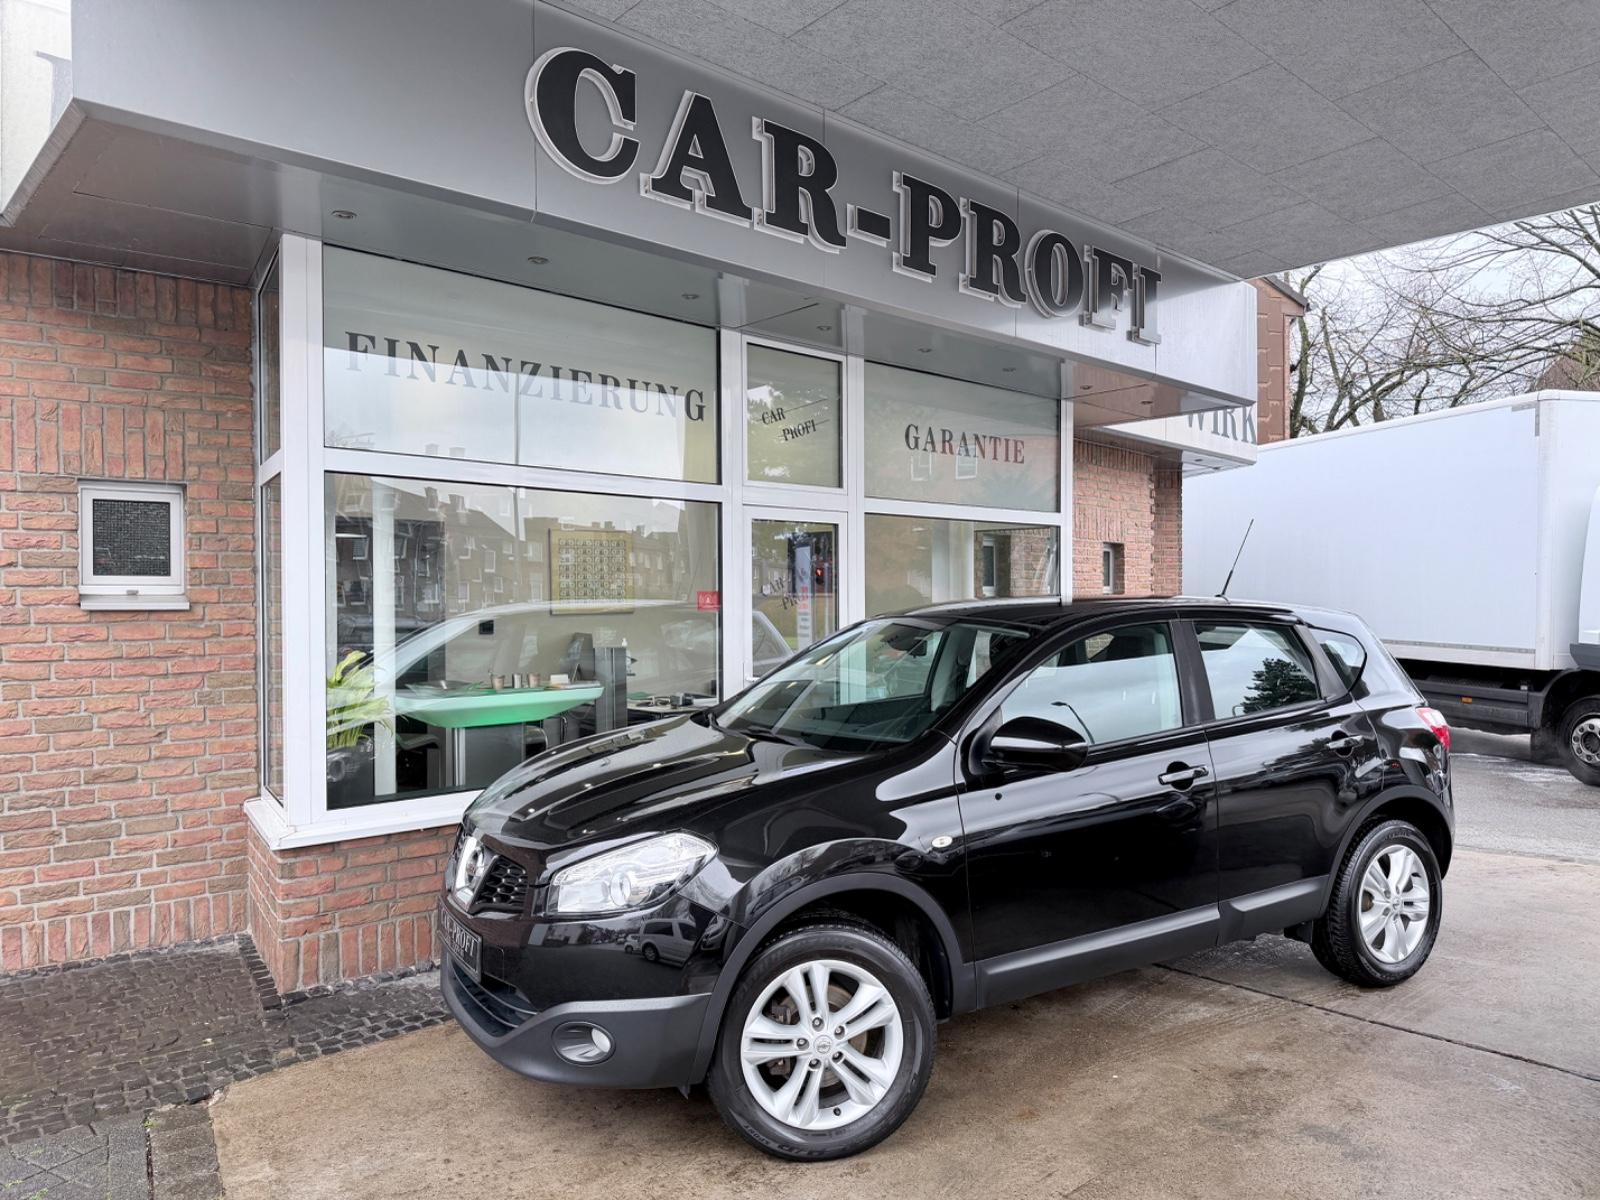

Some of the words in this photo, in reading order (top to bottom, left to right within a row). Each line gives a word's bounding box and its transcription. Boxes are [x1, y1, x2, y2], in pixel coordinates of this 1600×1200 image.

[524, 46, 1162, 345] CAR-PROFI
[345, 331, 706, 421] FINANZIERUNG
[761, 407, 786, 425] CAR
[782, 419, 817, 441] PROFI
[904, 423, 1025, 464] GARANTIE
